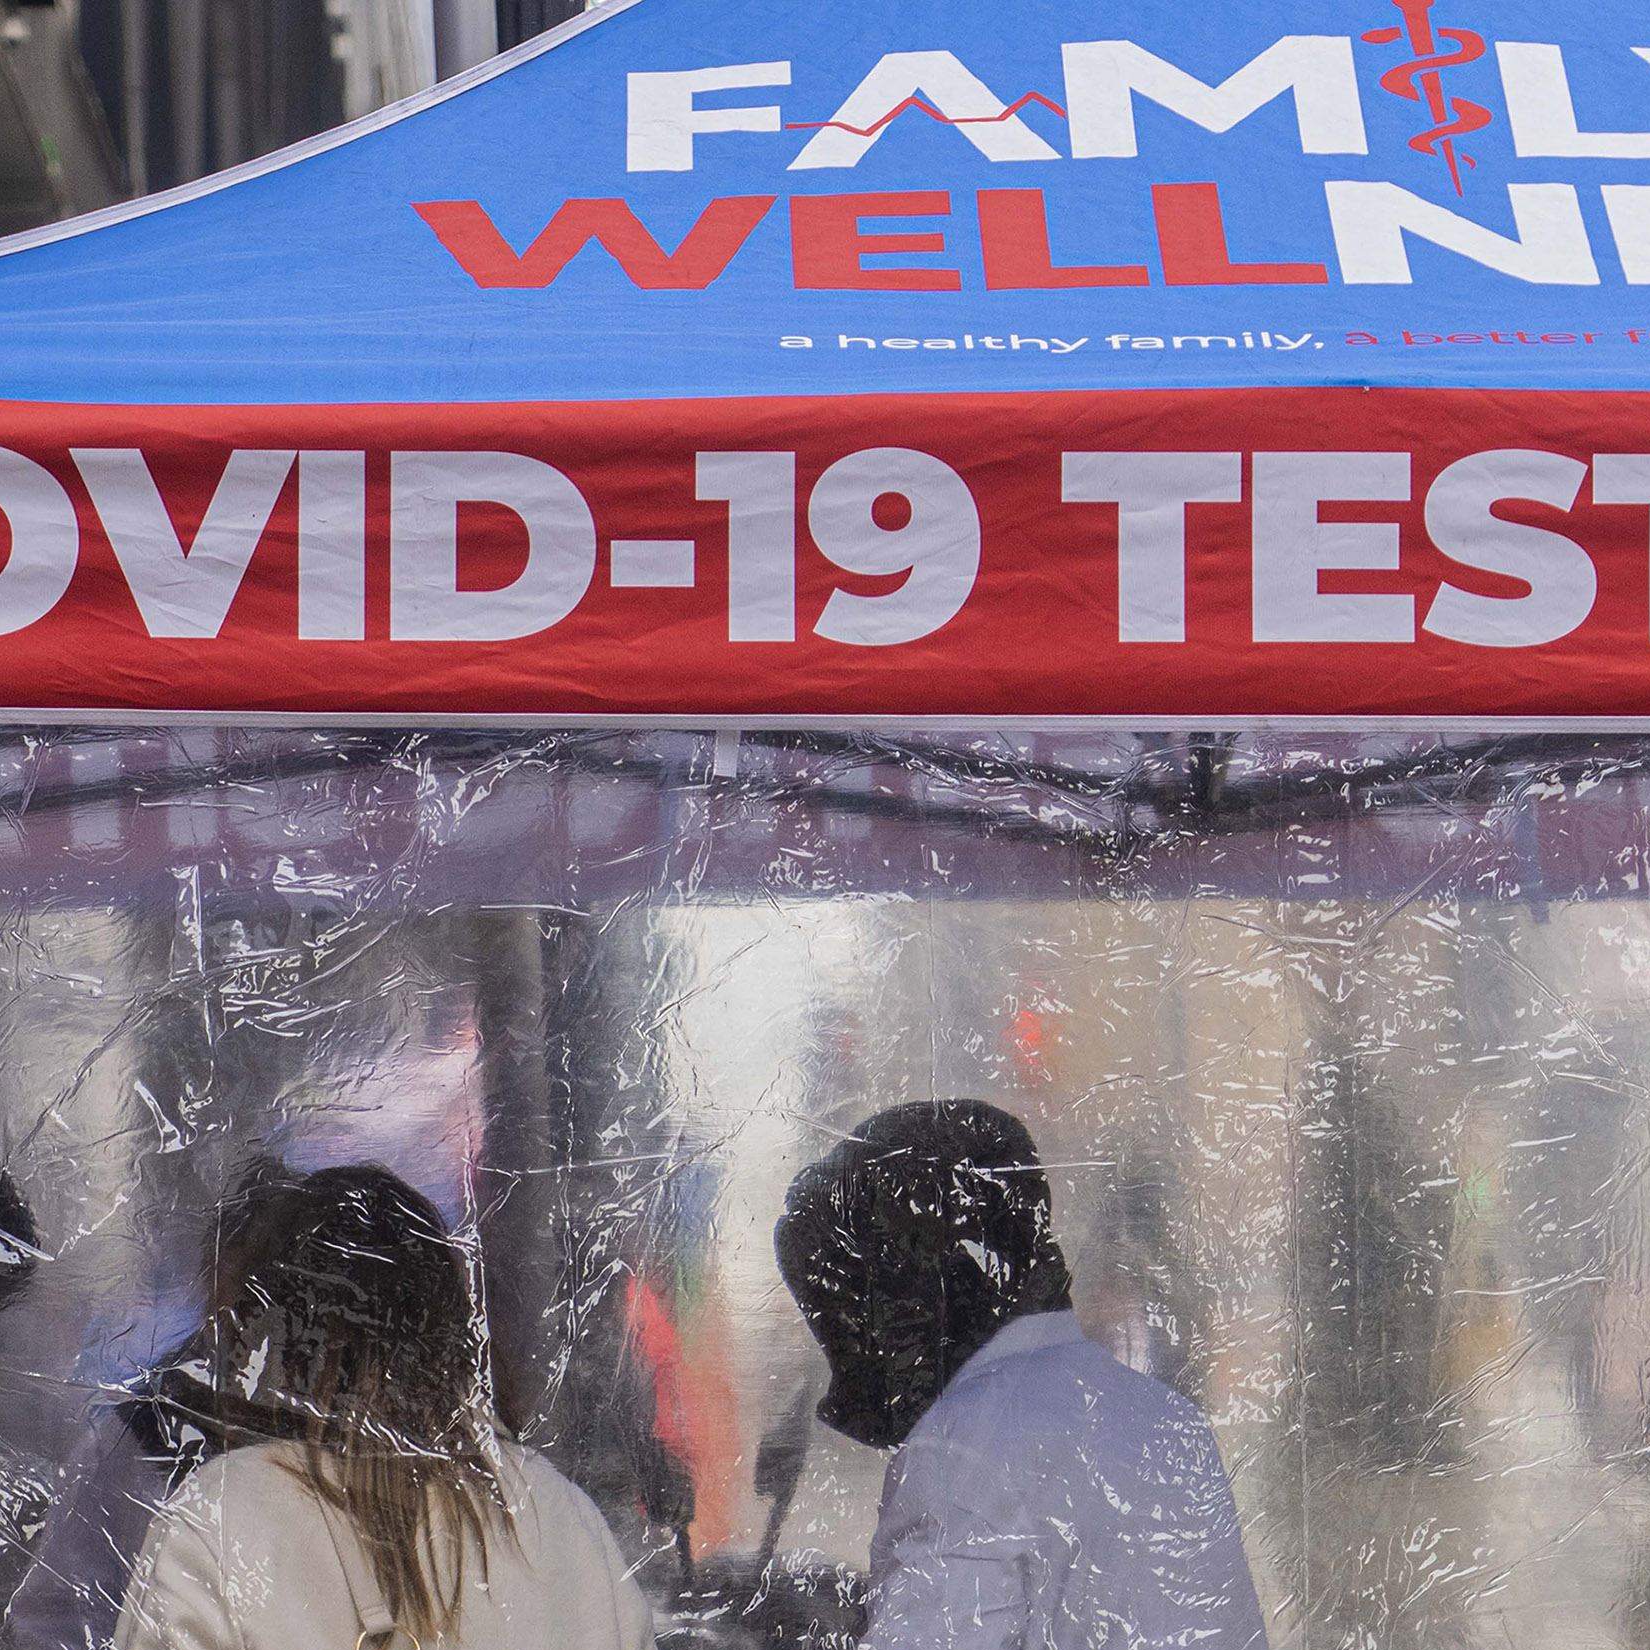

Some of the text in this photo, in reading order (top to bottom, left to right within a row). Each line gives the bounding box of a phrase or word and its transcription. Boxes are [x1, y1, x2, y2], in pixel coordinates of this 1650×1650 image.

[779, 336, 813, 349] a
[838, 334, 1089, 353] healthy
[1104, 332, 1325, 350] family,
[1345, 332, 1378, 345] a
[1401, 331, 1604, 346] better
